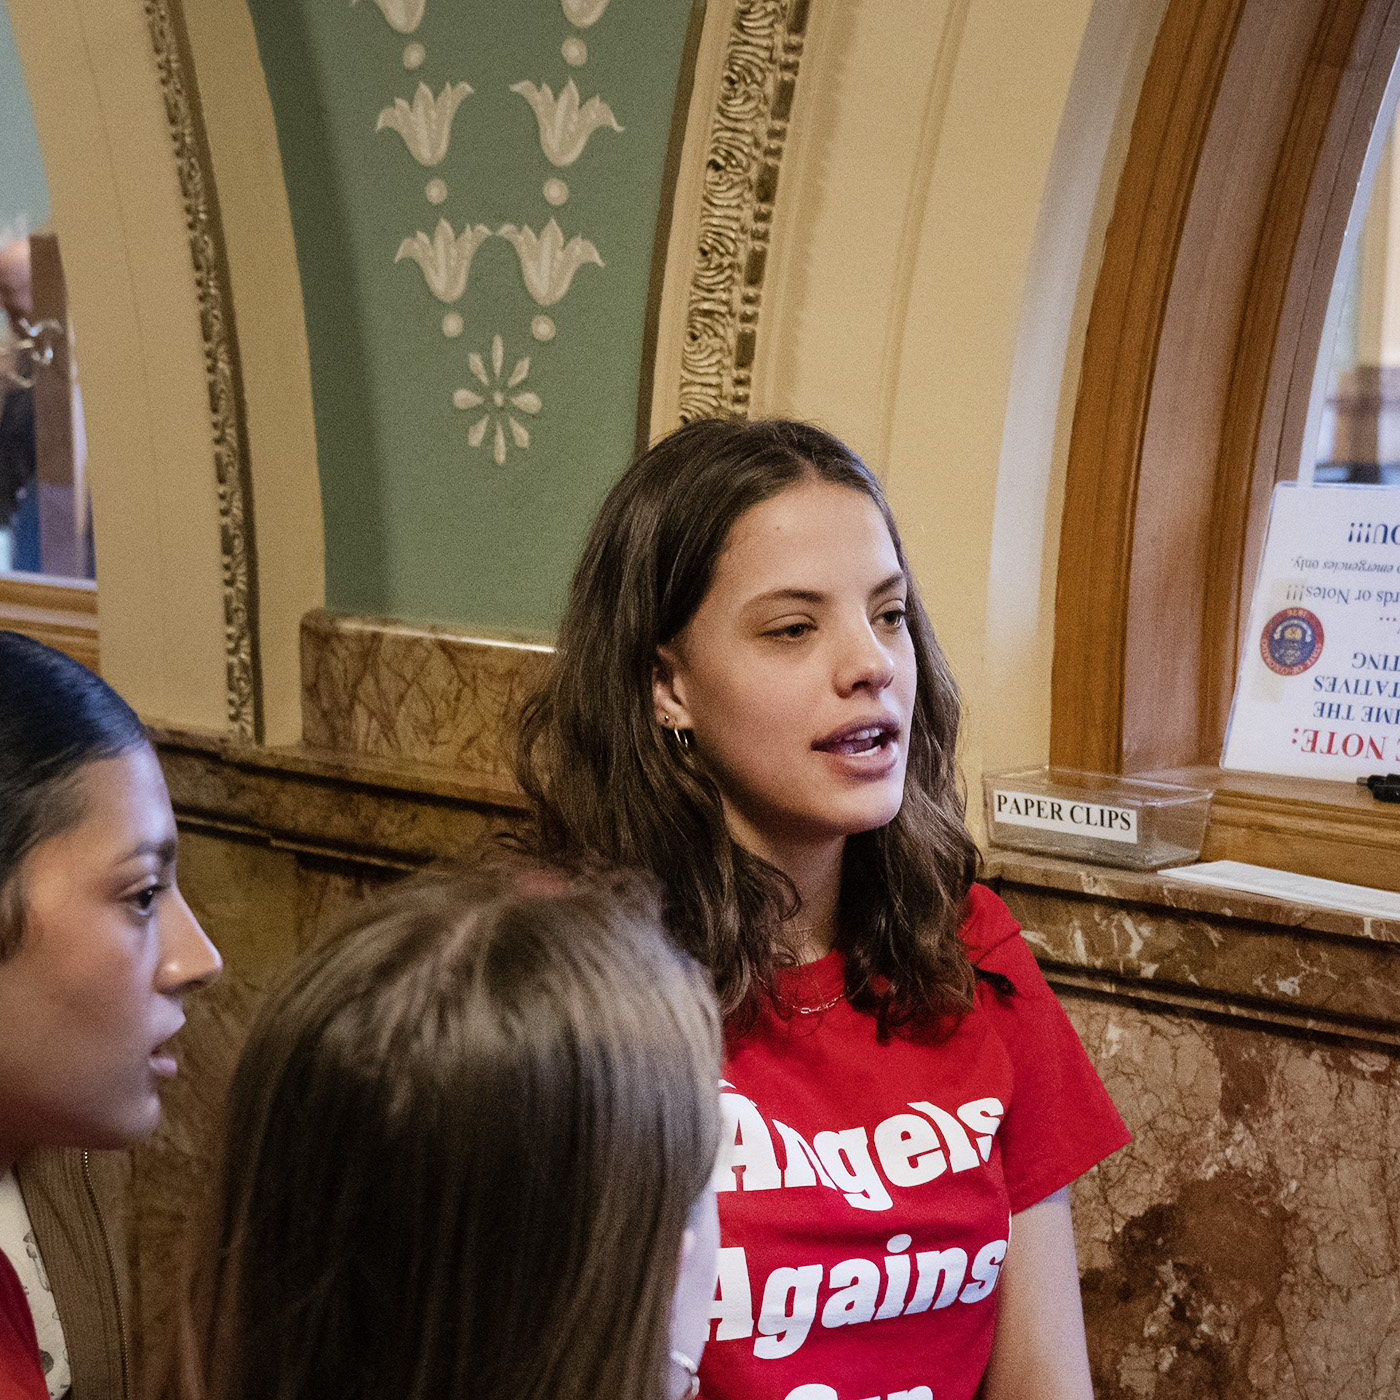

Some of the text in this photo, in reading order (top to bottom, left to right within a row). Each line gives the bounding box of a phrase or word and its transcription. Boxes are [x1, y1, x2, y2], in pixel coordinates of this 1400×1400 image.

[1290, 557, 1319, 571] only.
[1323, 559, 1394, 574] emergencies
[1285, 584, 1351, 604] Notes!!!
[1355, 589, 1372, 601] or
[1312, 701, 1355, 721] THE
[1291, 727, 1387, 761] NOTE:
[996, 794, 1132, 832] PAPER CLIPS
[716, 1092, 1005, 1211] Angels
[704, 1233, 1010, 1360] Agains
